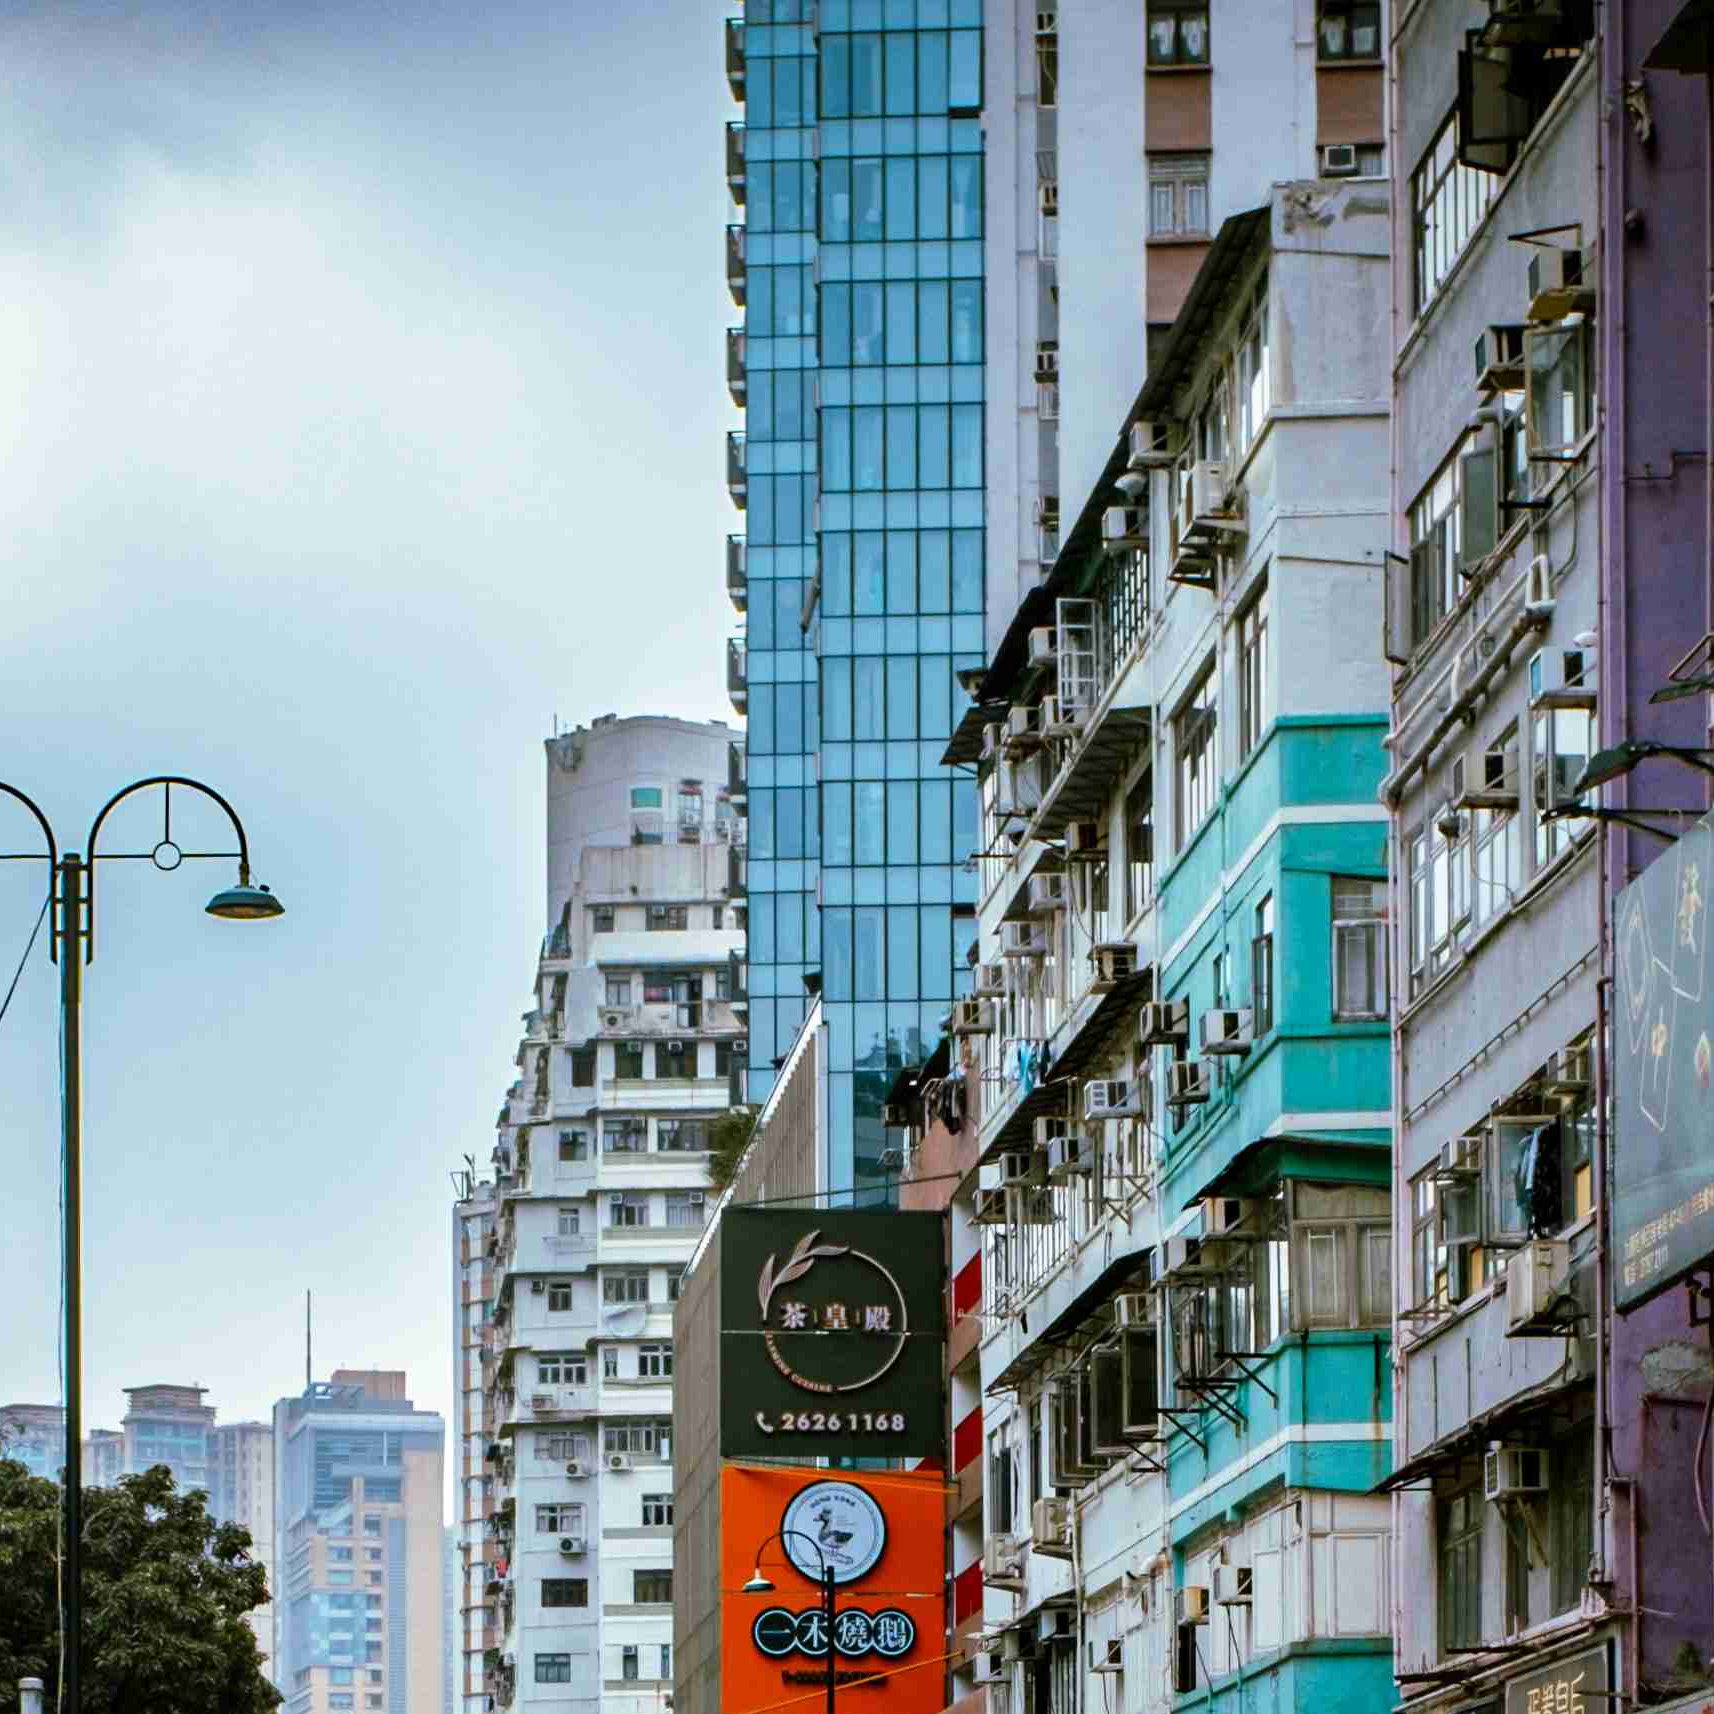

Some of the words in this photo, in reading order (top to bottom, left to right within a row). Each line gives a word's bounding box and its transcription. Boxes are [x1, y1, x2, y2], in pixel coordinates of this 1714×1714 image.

[780, 1302, 892, 1331] 茶皇殿
[781, 1412, 842, 1432] 2626
[847, 1412, 906, 1432] 1168
[761, 1614, 908, 1649] 一木燒鵝
